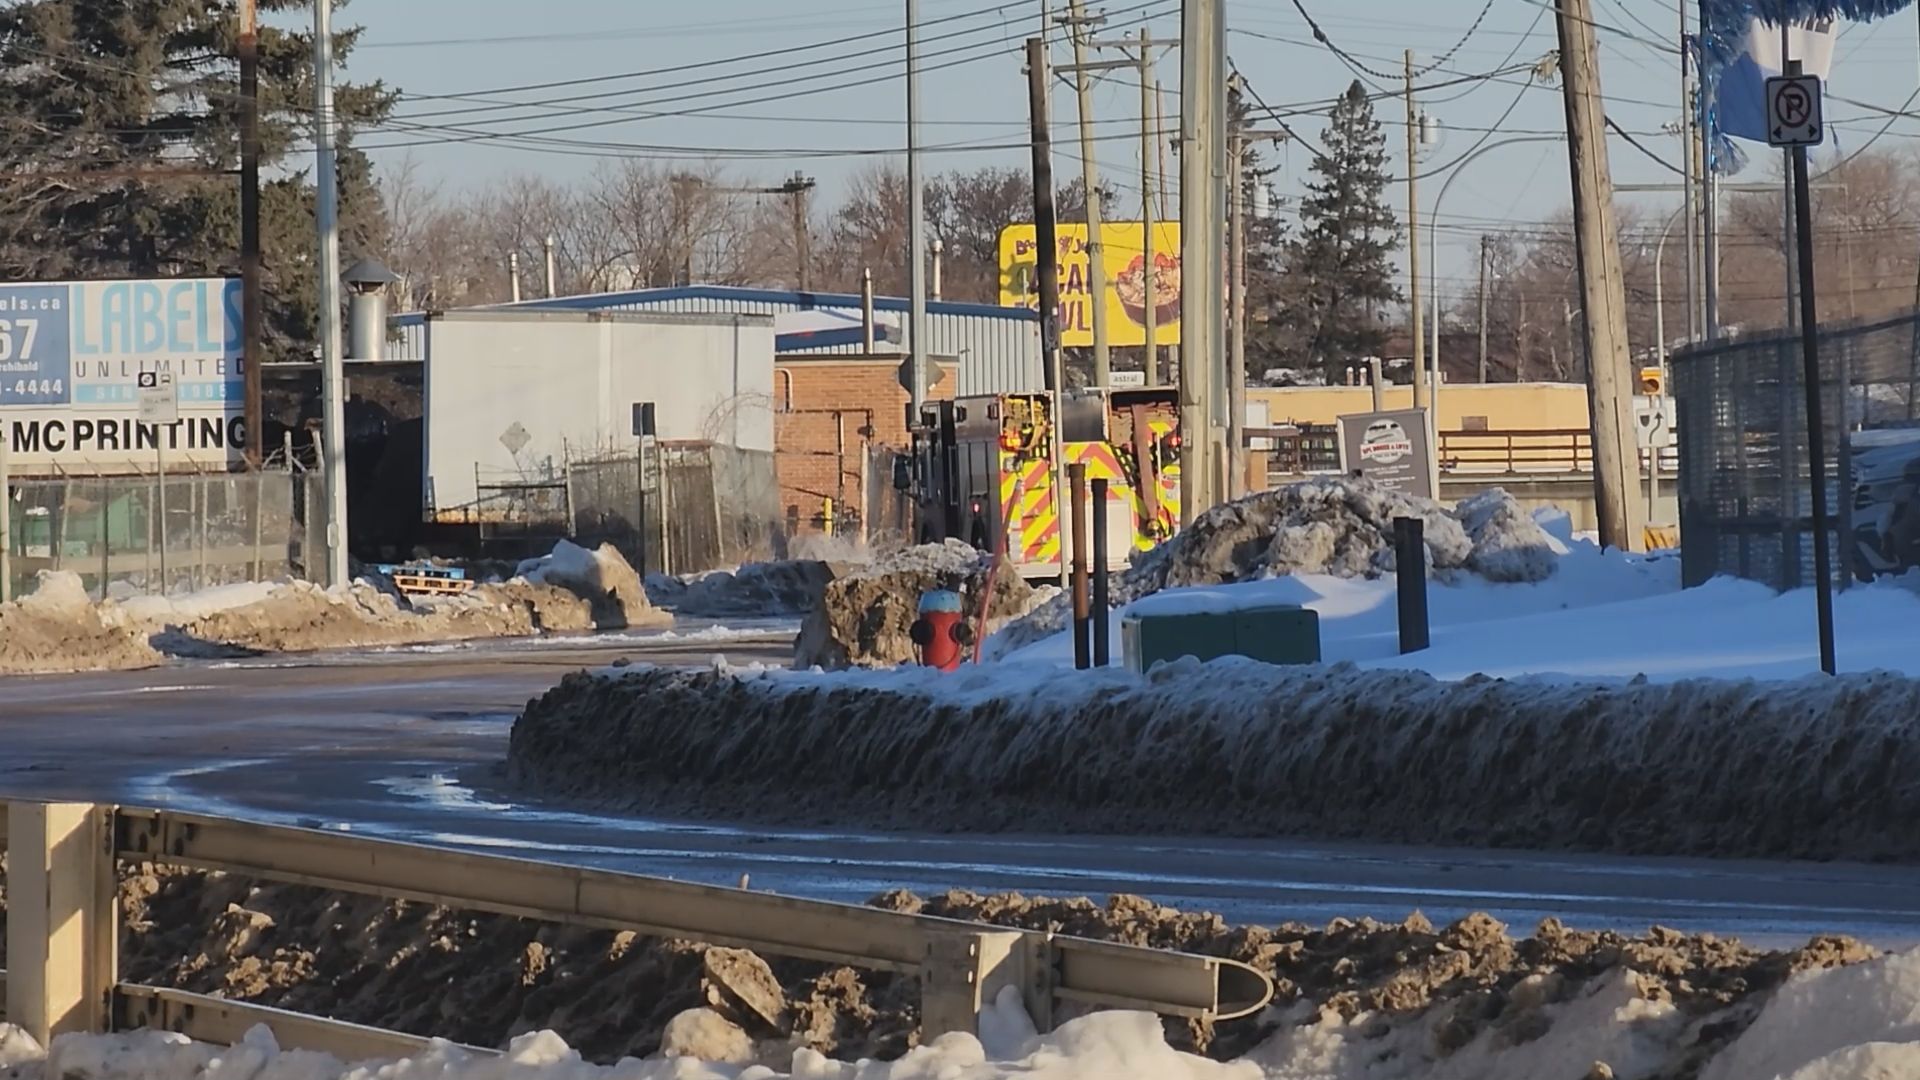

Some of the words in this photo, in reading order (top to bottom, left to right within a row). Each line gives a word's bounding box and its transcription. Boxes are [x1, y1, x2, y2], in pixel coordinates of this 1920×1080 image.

[75, 281, 243, 354] LABELS
[76, 359, 244, 378] UNLIMITED
[13, 421, 65, 452] MC
[73, 417, 245, 451] PRINTING
